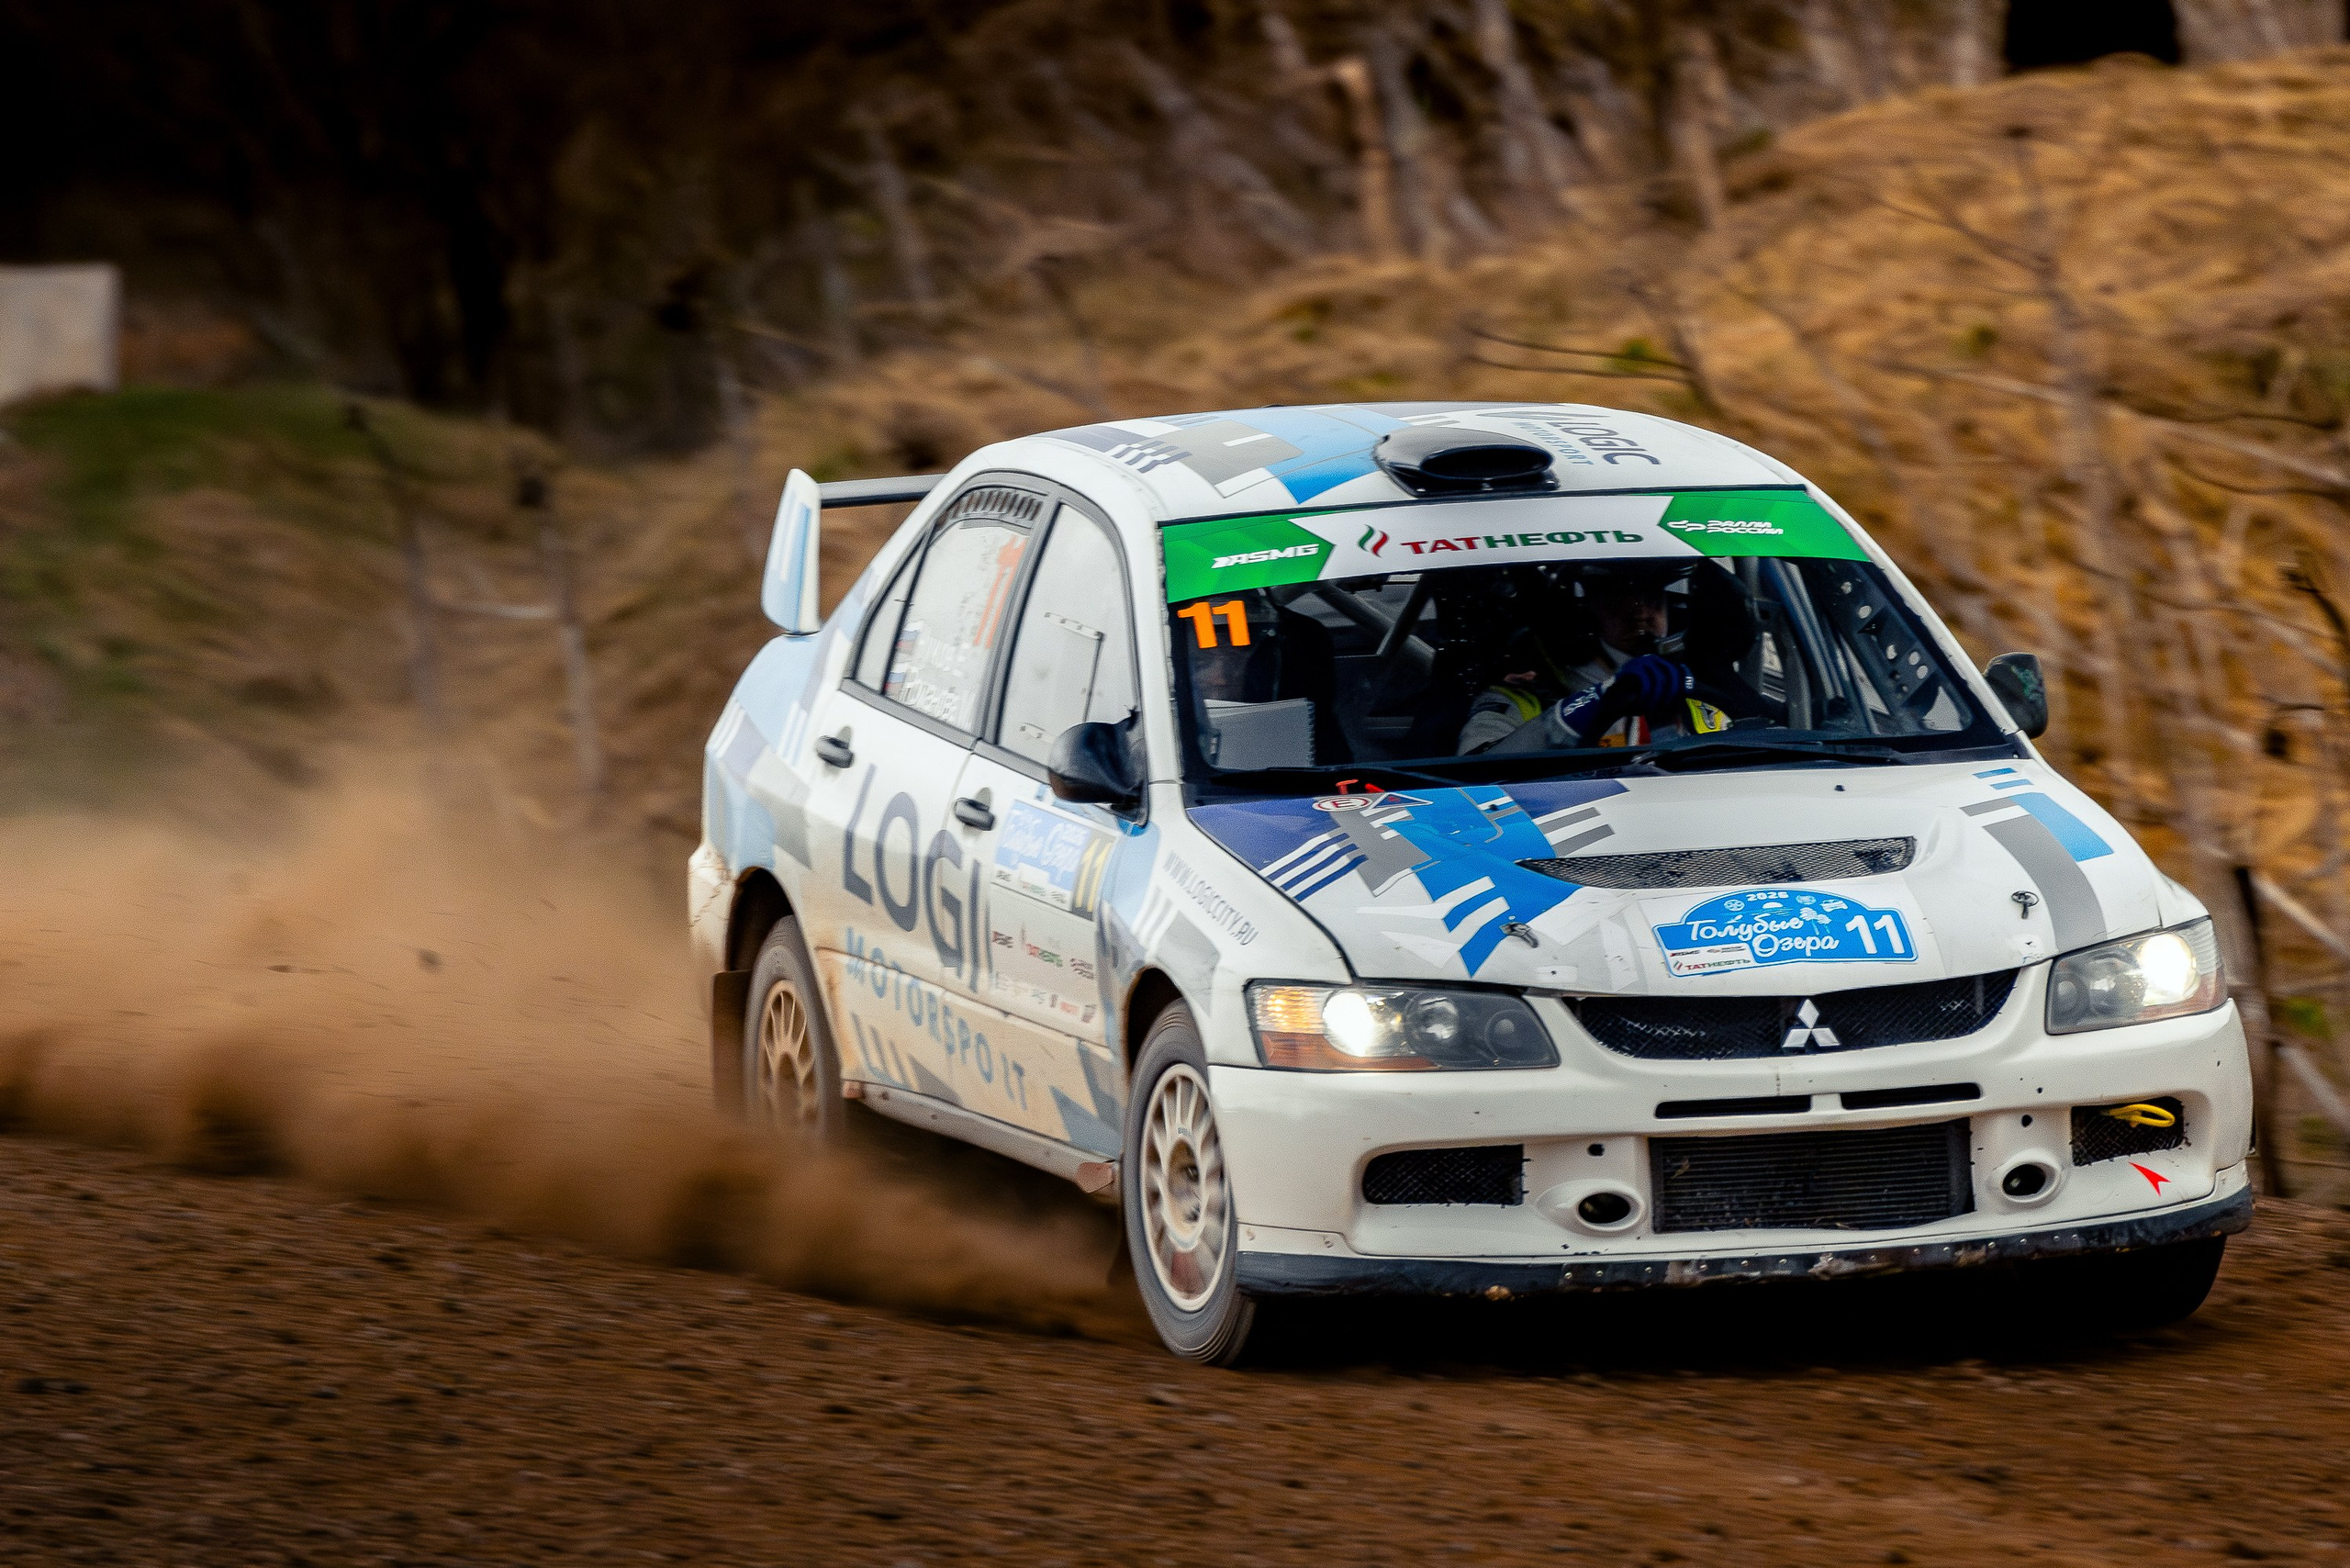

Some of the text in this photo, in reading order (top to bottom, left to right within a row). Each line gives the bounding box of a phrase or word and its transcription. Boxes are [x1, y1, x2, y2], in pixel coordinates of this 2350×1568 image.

[1547, 422, 1662, 465] LOGIC
[1402, 529, 1644, 557] ТАТНЕФТЬ
[1177, 599, 1251, 650] 11
[844, 763, 993, 993] LOGI
[1076, 837, 1113, 913] 11
[1845, 914, 1905, 955] 11
